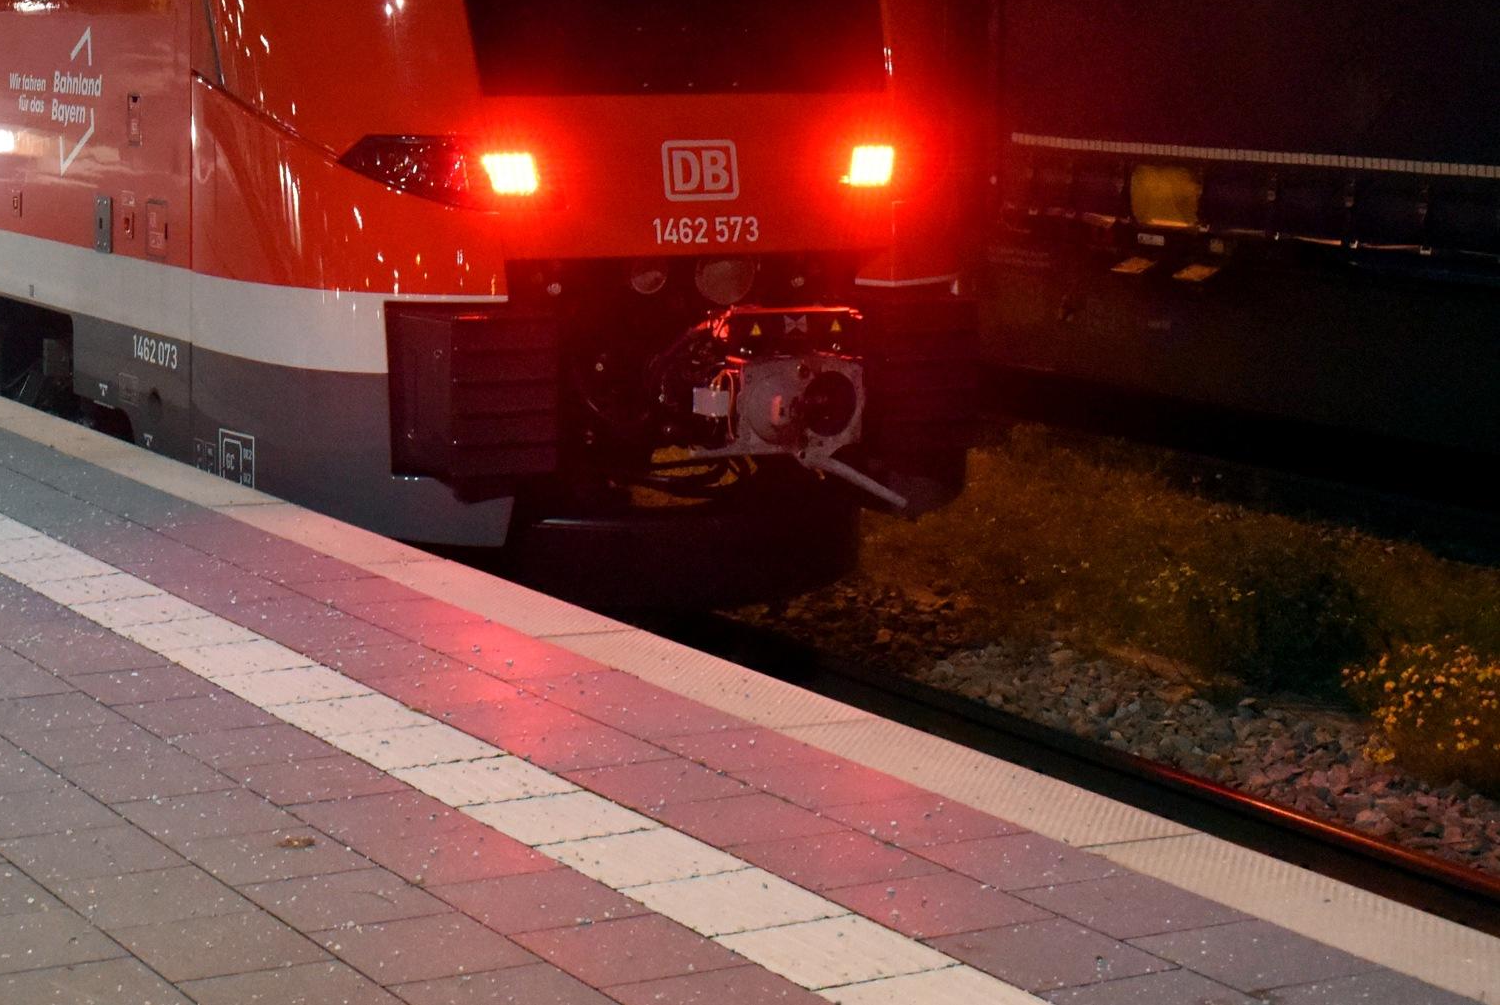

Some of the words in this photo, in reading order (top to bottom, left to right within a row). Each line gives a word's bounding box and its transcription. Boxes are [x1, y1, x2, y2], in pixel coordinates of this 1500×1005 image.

[9, 72, 21, 90] Wir
[22, 73, 46, 91] fahren
[53, 70, 102, 97] Bahnland
[18, 94, 29, 111] für
[30, 96, 45, 113] das
[52, 98, 85, 127] Bayern
[670, 147, 731, 193] DB
[652, 217, 709, 245] 1462
[715, 216, 759, 243] 573
[133, 334, 156, 364] 1462
[158, 341, 178, 370] 073
